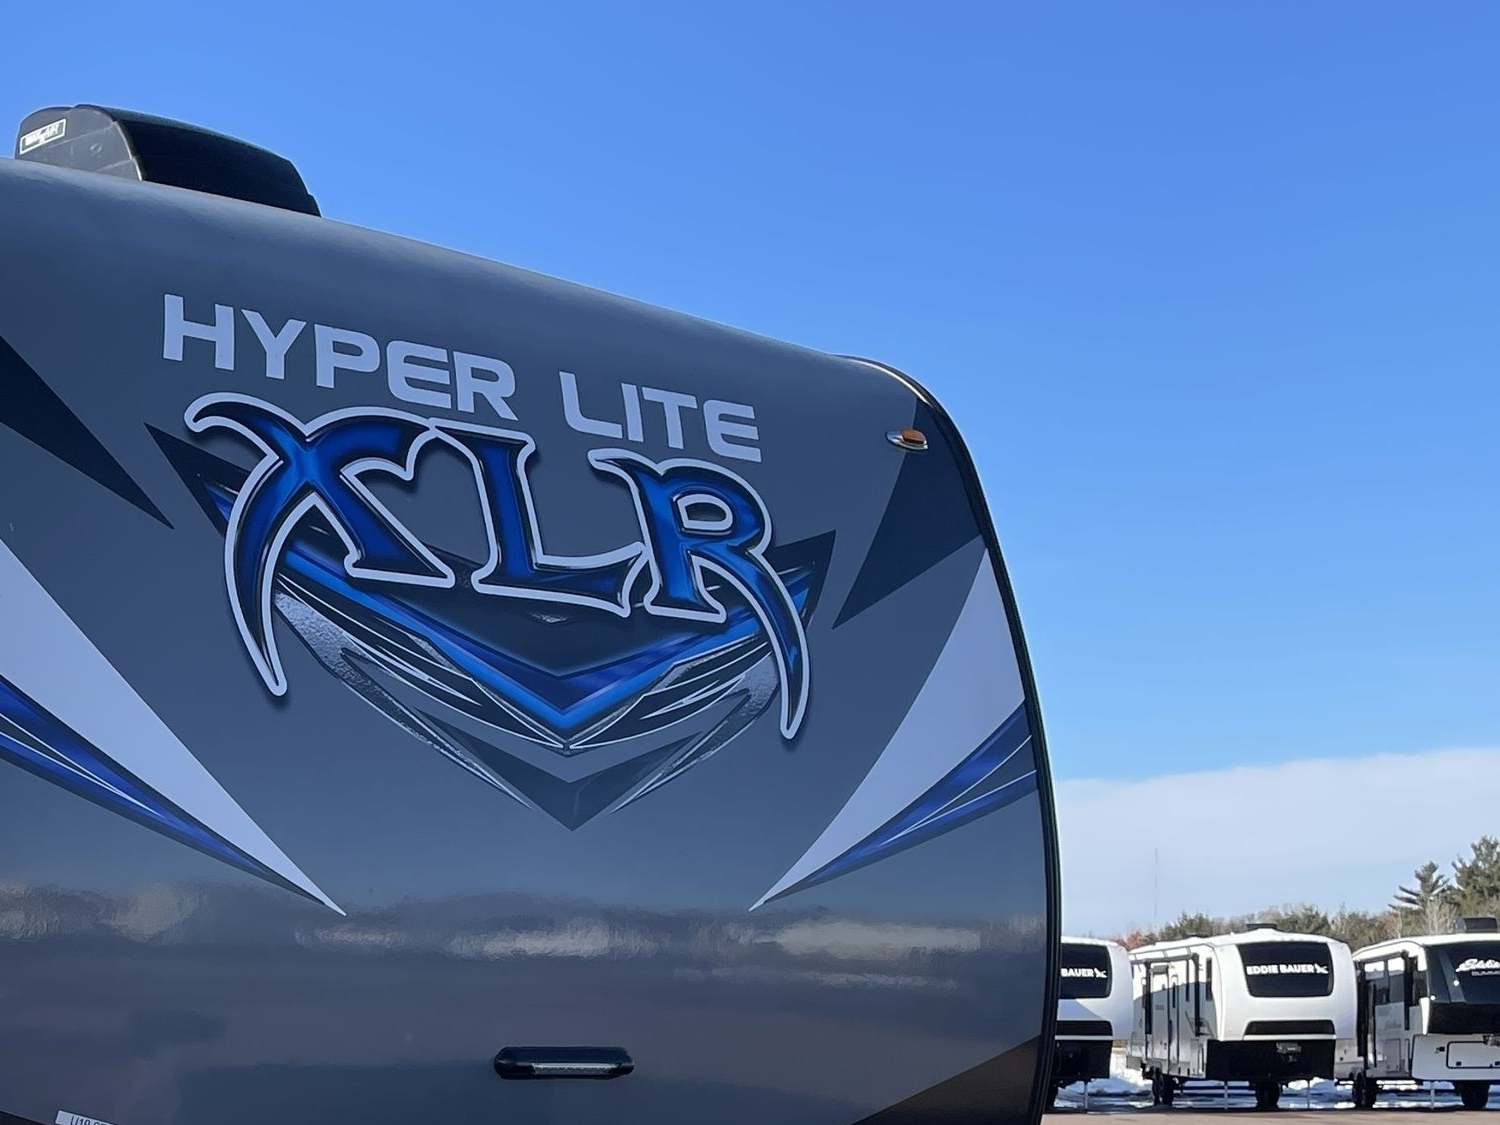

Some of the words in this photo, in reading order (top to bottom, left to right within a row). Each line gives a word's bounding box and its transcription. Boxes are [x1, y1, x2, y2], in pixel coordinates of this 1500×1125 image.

[162, 293, 519, 422] HYPER
[558, 370, 764, 464] LITE
[183, 391, 812, 741] XLR
[1060, 967, 1095, 978] BAUER
[1245, 964, 1279, 976] EDDIE
[1279, 963, 1315, 974] BAUER
